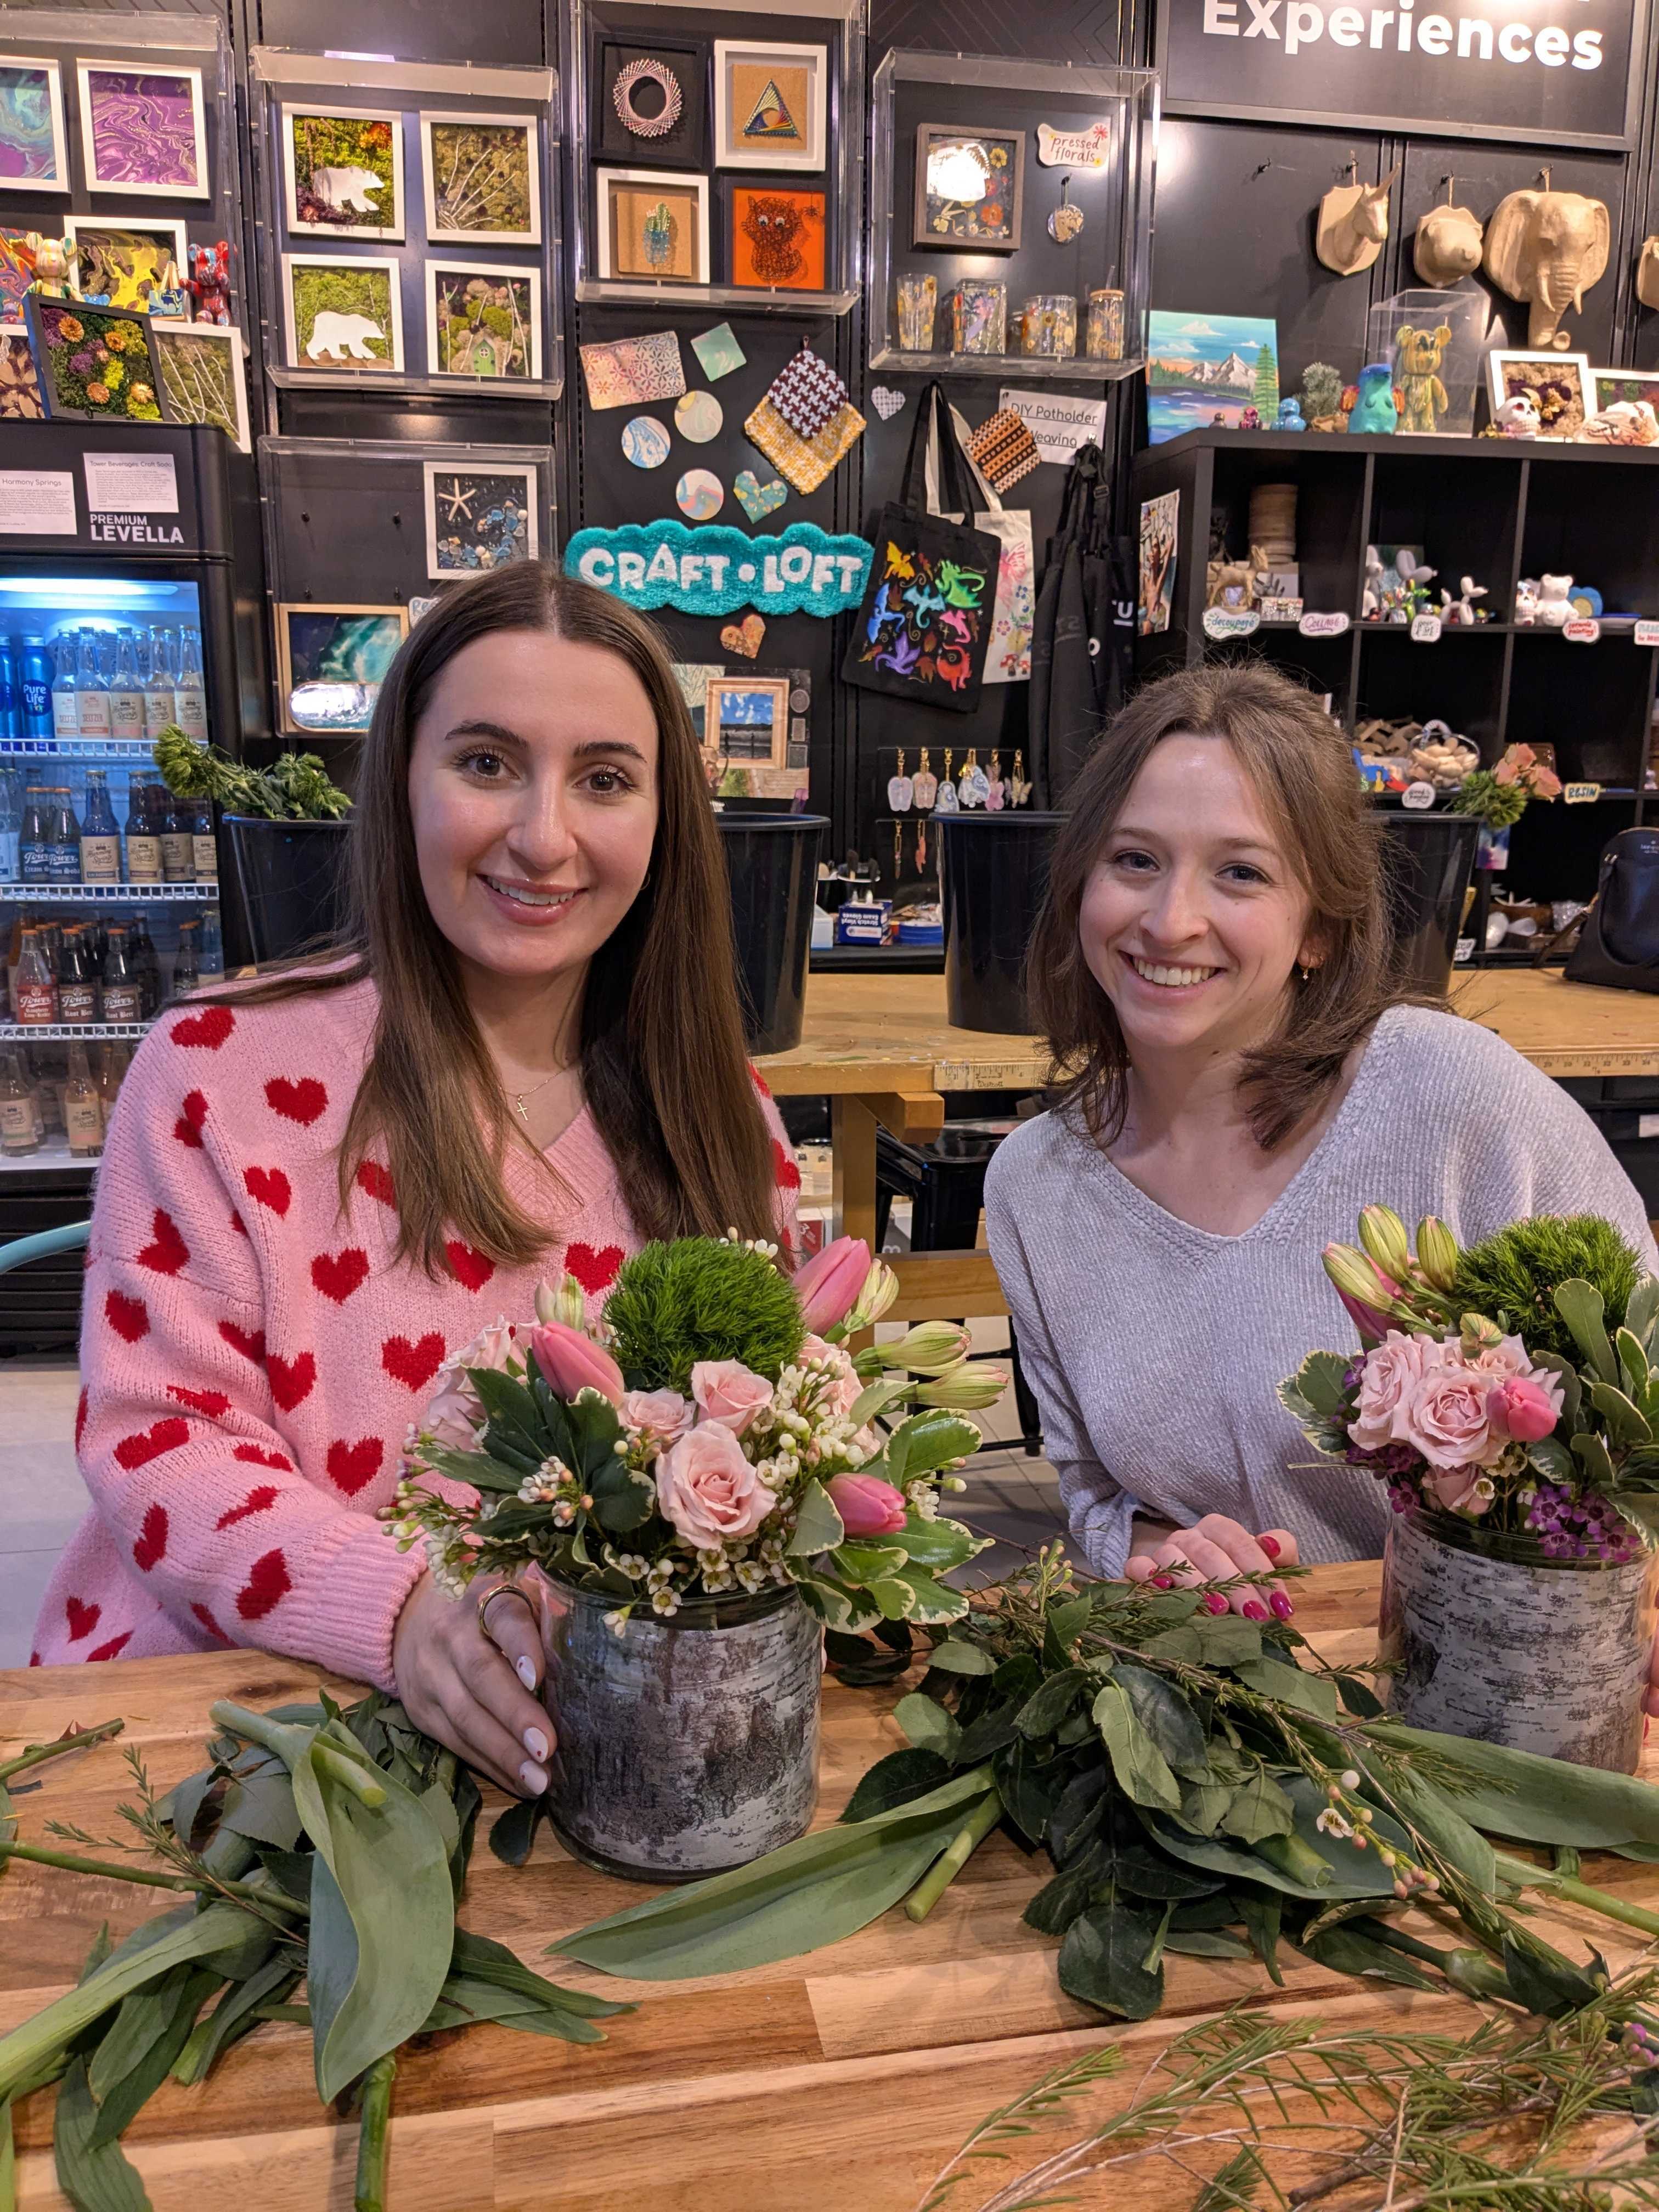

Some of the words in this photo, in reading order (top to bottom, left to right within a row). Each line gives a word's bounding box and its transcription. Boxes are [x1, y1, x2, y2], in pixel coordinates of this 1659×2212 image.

[1203, 0, 1603, 70] Experiences
[1051, 136, 1101, 152] pressed
[1056, 146, 1095, 162] florals
[1011, 403, 1032, 416] DIY
[1036, 405, 1098, 424] Potholder
[90, 514, 148, 526] PREMIUM
[91, 524, 184, 544] LEVELLA
[579, 544, 730, 591] CRAFT
[763, 546, 863, 592] LOFT
[23, 685, 46, 694] Pure
[26, 694, 44, 704] Life
[20, 996, 52, 1008] Tower
